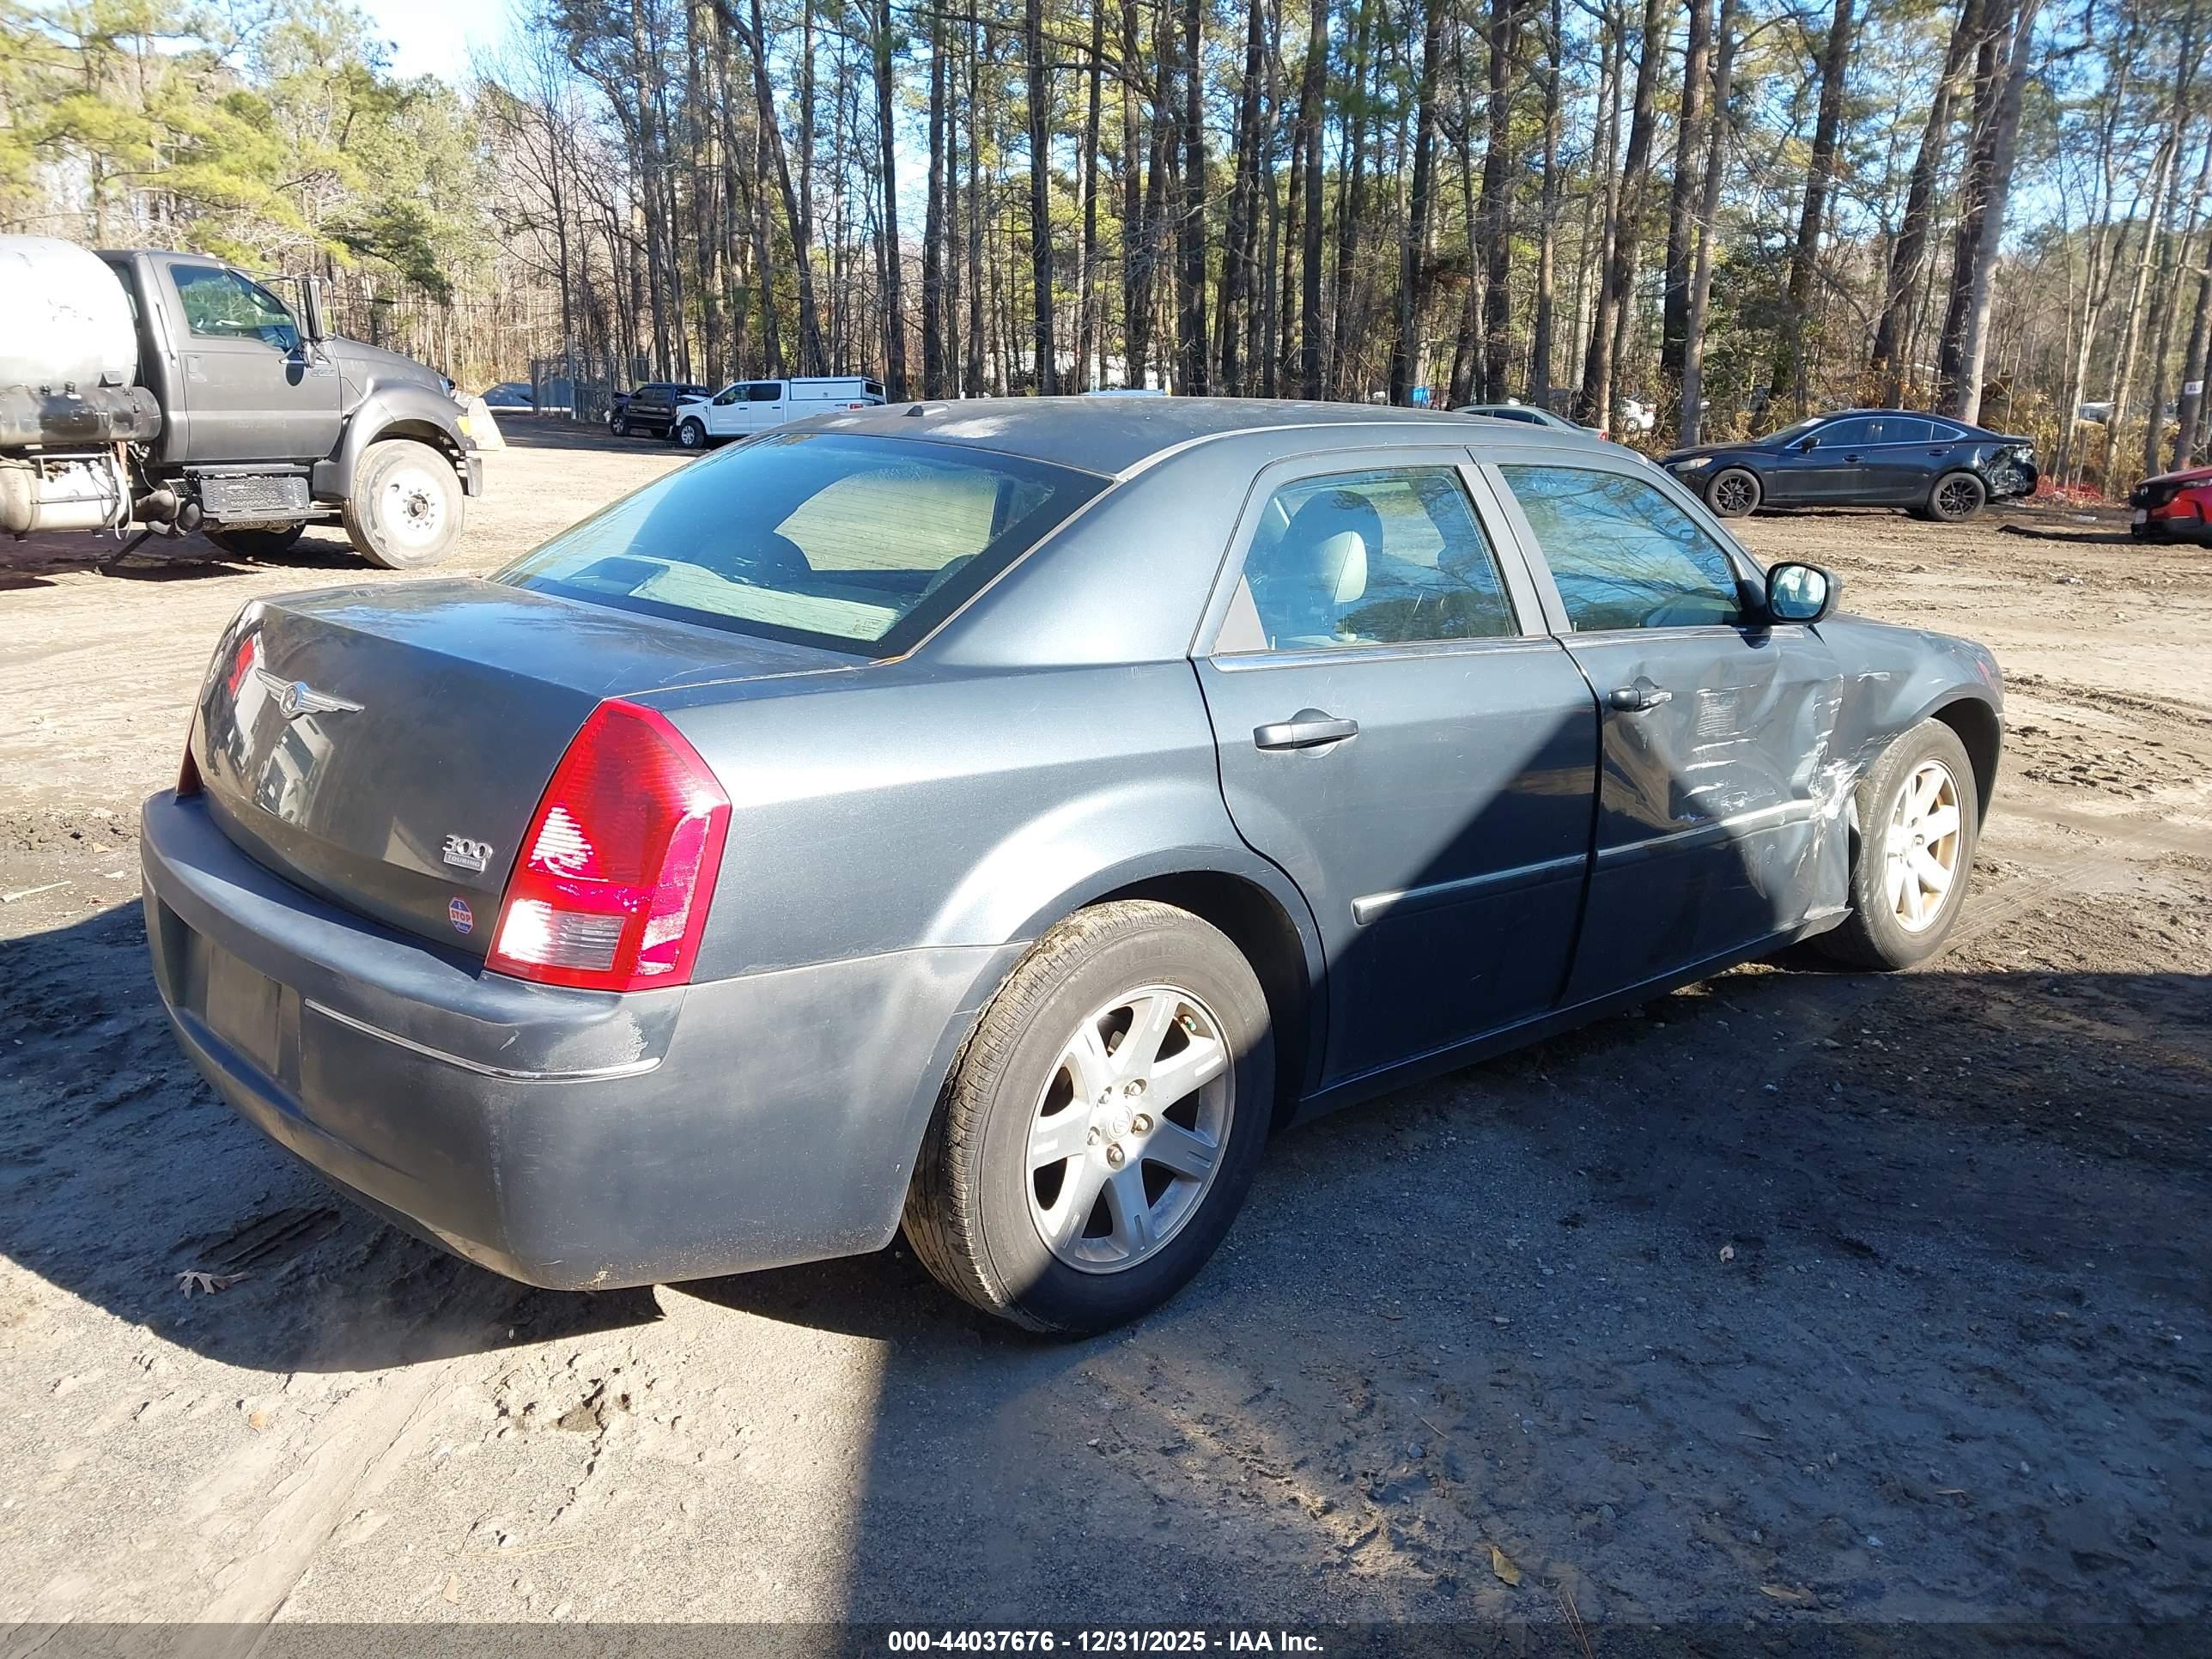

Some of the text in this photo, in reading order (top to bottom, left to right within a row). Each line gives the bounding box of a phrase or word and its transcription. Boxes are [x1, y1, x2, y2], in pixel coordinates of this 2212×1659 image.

[442, 835, 493, 859] 300
[447, 854, 481, 868] TOURING
[451, 910, 471, 922] STOP
